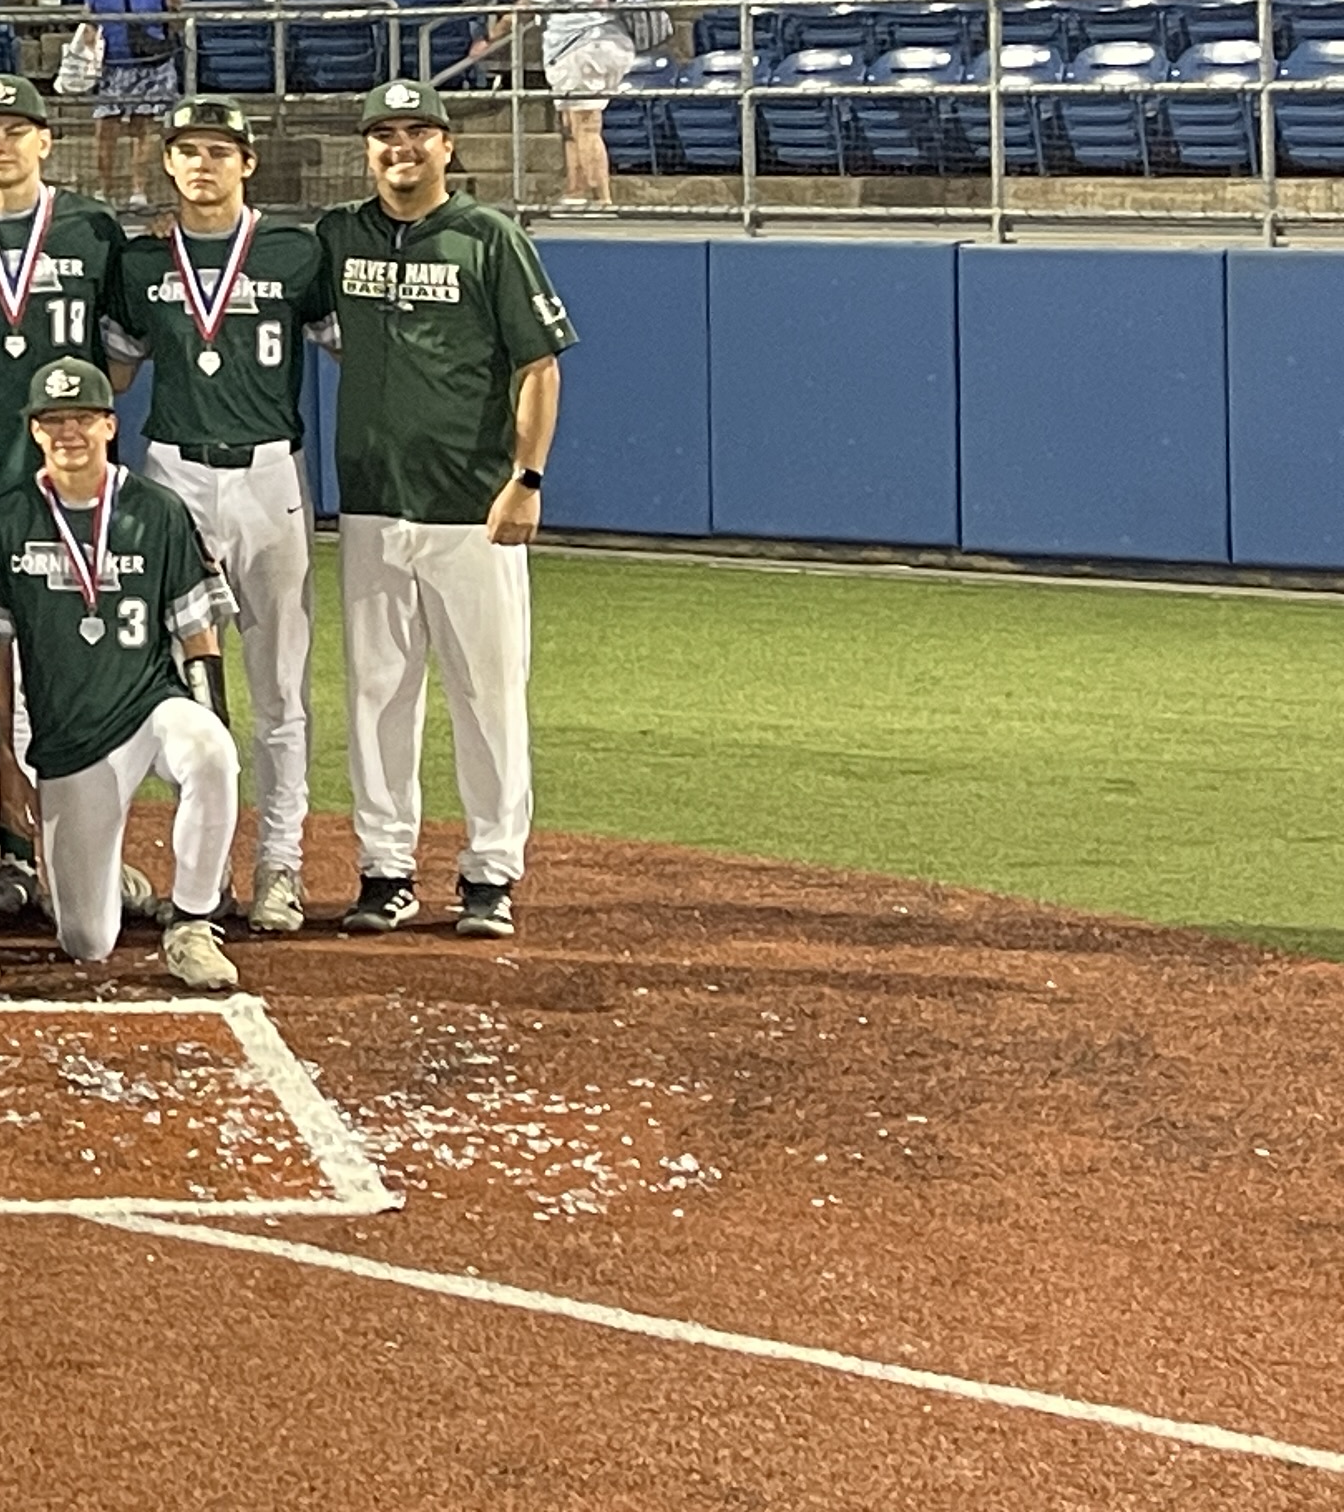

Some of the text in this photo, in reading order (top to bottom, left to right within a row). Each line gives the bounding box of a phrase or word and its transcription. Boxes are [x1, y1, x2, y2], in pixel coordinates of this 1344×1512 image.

[343, 257, 460, 286] SILVER HAWK
[345, 280, 456, 301] BASBALL
[147, 281, 283, 302] CORSKER
[46, 299, 86, 346] 18
[256, 320, 283, 368] 6
[117, 596, 148, 648] 3
